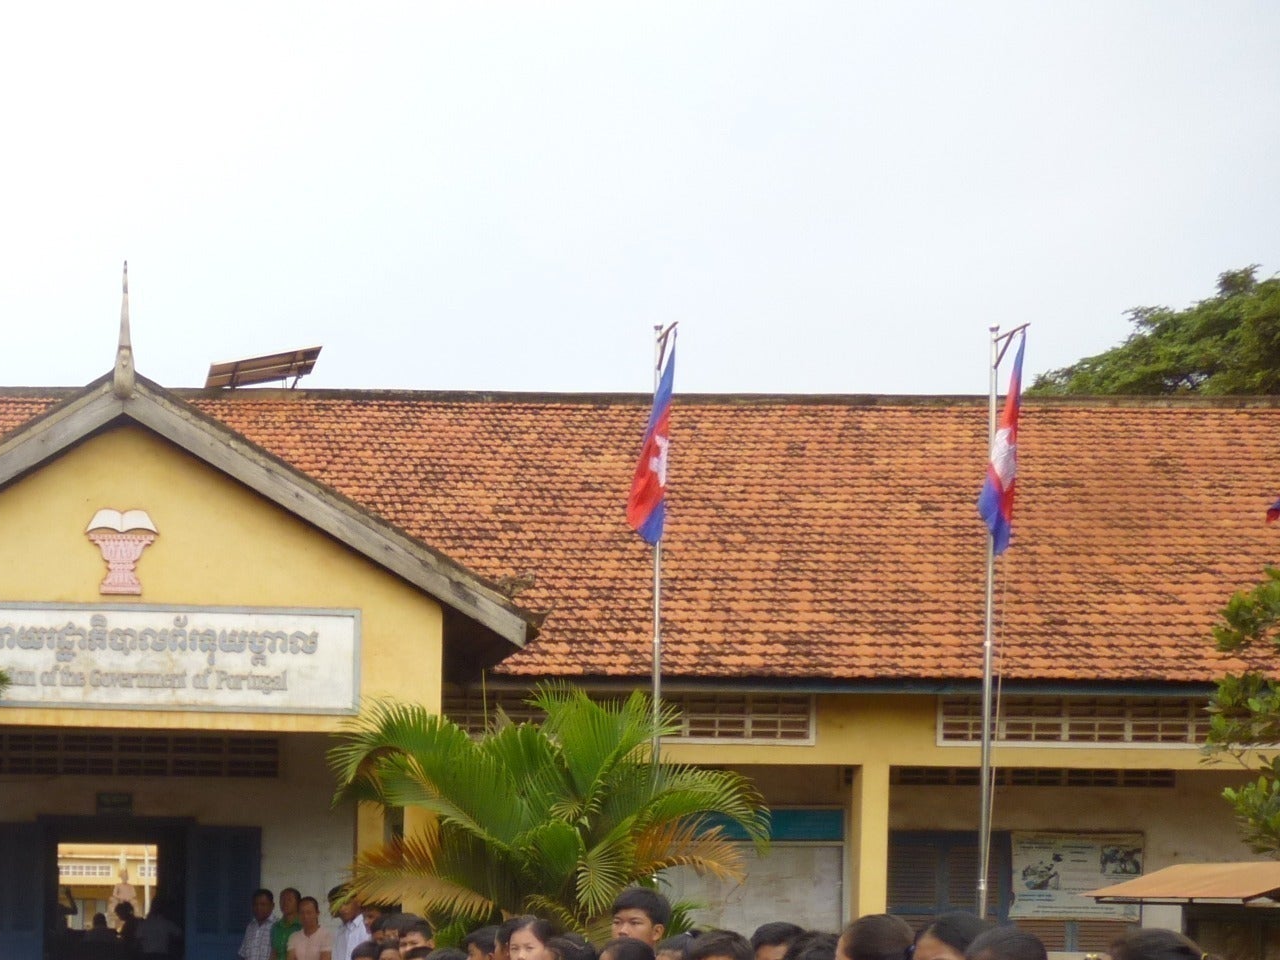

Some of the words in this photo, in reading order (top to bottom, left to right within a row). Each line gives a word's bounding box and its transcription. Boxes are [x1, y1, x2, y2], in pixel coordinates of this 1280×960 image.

[40, 665, 61, 687] of
[61, 665, 86, 688] the
[90, 669, 187, 690] Government
[192, 667, 213, 690] of
[216, 669, 288, 695] Portugal
